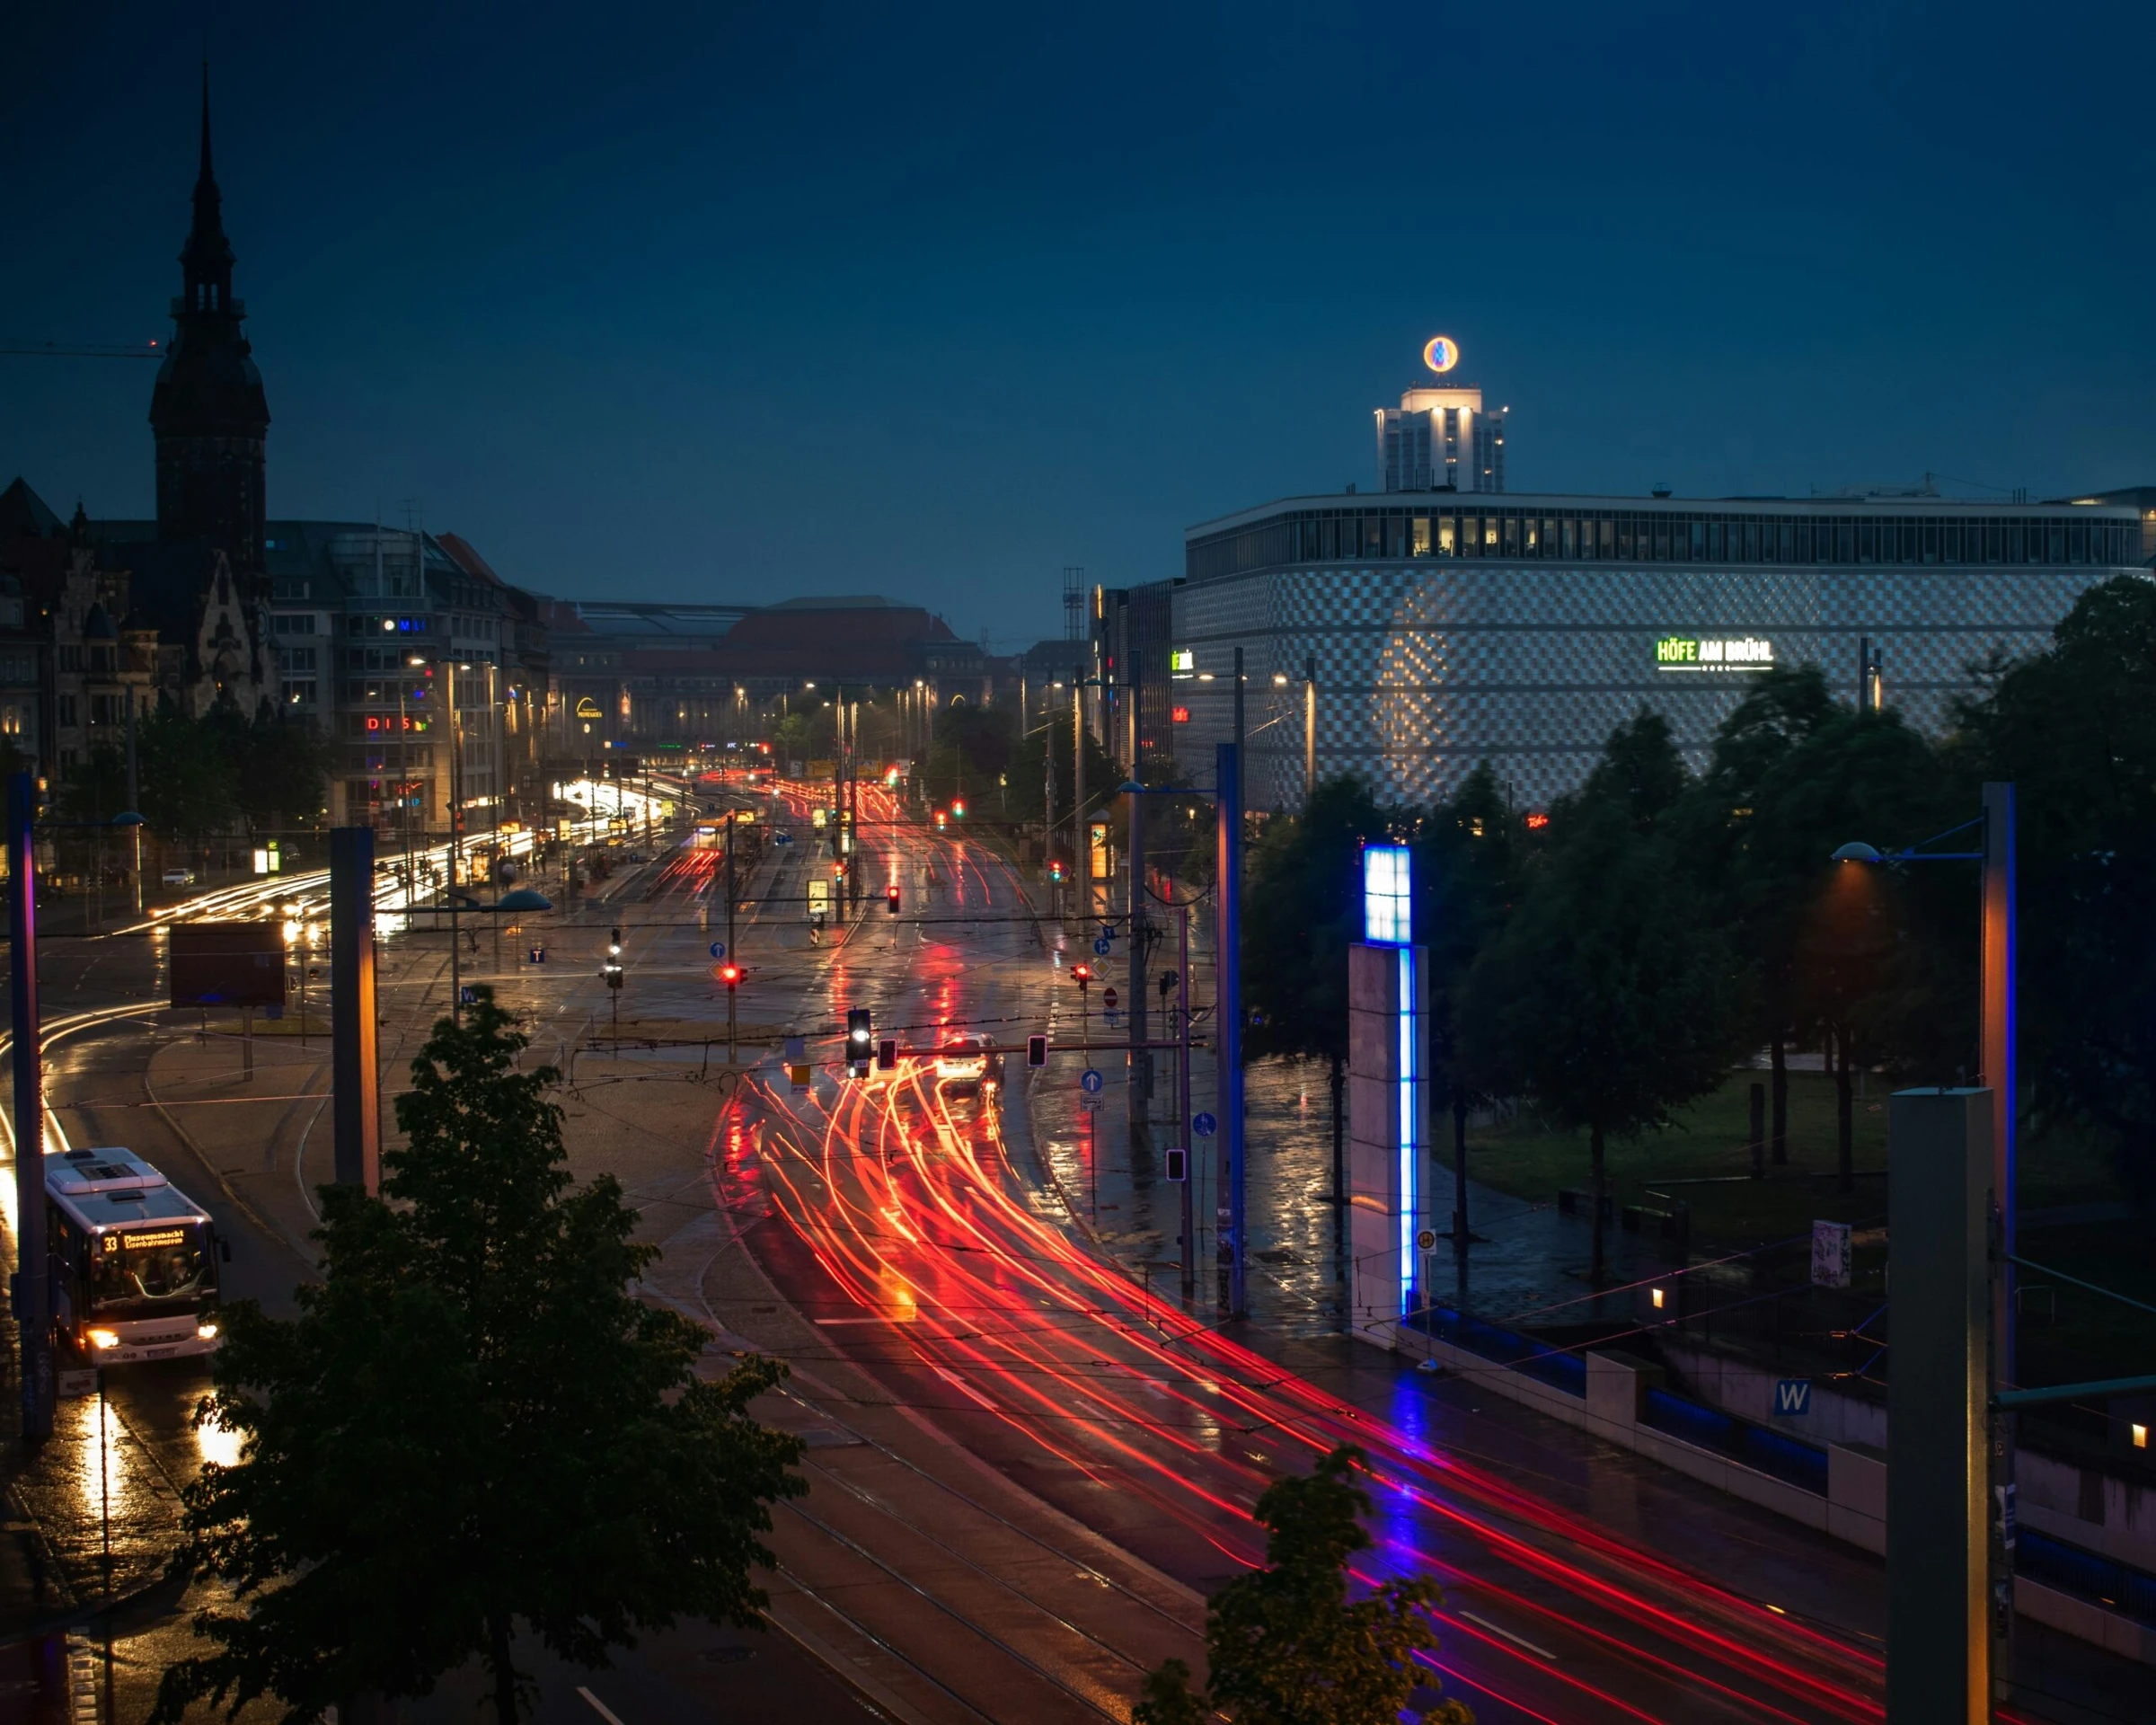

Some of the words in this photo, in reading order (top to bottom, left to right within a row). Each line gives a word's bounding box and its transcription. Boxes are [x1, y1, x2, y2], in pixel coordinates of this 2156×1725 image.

[1657, 637, 1696, 661] HÖFE
[1699, 641, 1723, 661] AM
[1725, 637, 1773, 661] BRÜHL
[104, 1236, 117, 1252] 33
[1780, 1384, 1808, 1411] W
